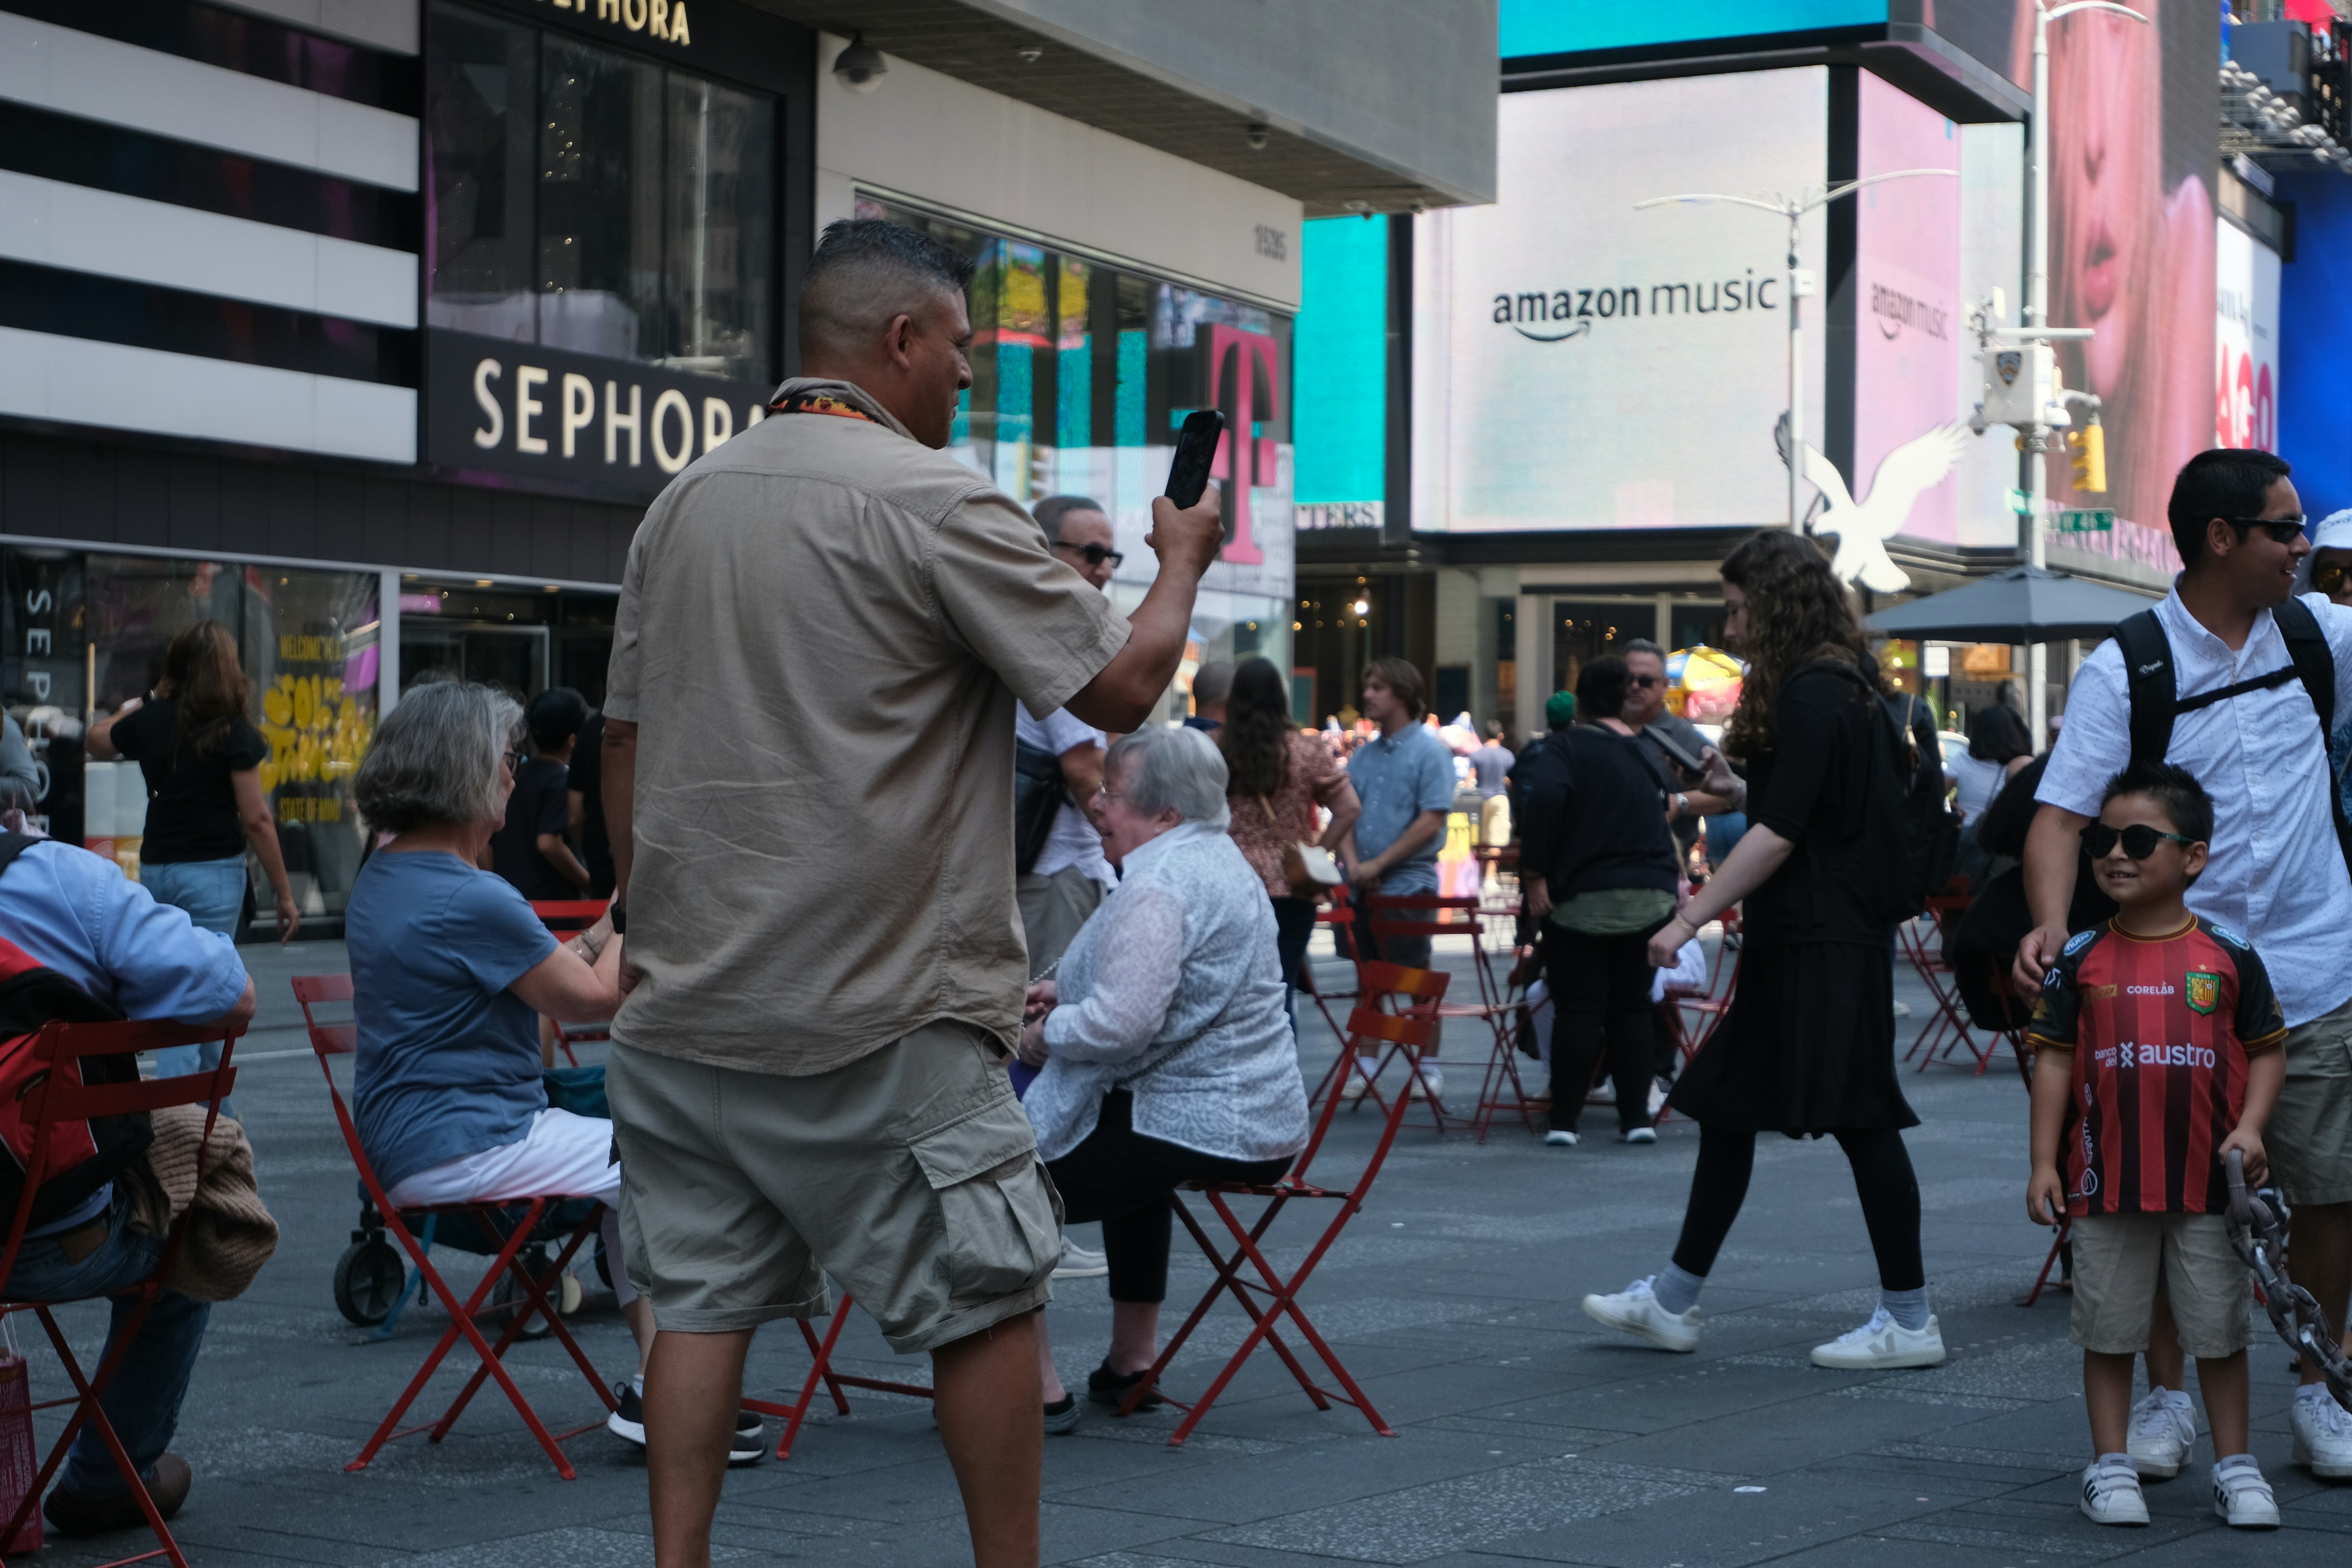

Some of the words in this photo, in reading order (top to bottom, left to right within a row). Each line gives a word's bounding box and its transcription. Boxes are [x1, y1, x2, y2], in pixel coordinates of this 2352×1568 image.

[534, 0, 691, 46] HORA
[1493, 285, 1640, 325] amazon
[1651, 268, 1778, 315] music
[1871, 282, 1916, 329] amazon
[1917, 299, 1949, 340] music
[473, 358, 765, 474] SEPHOR
[2127, 983, 2174, 994] CORELAB
[2095, 1046, 2117, 1060] banco
[2105, 1055, 2118, 1068] del
[2139, 1043, 2216, 1069] austro
